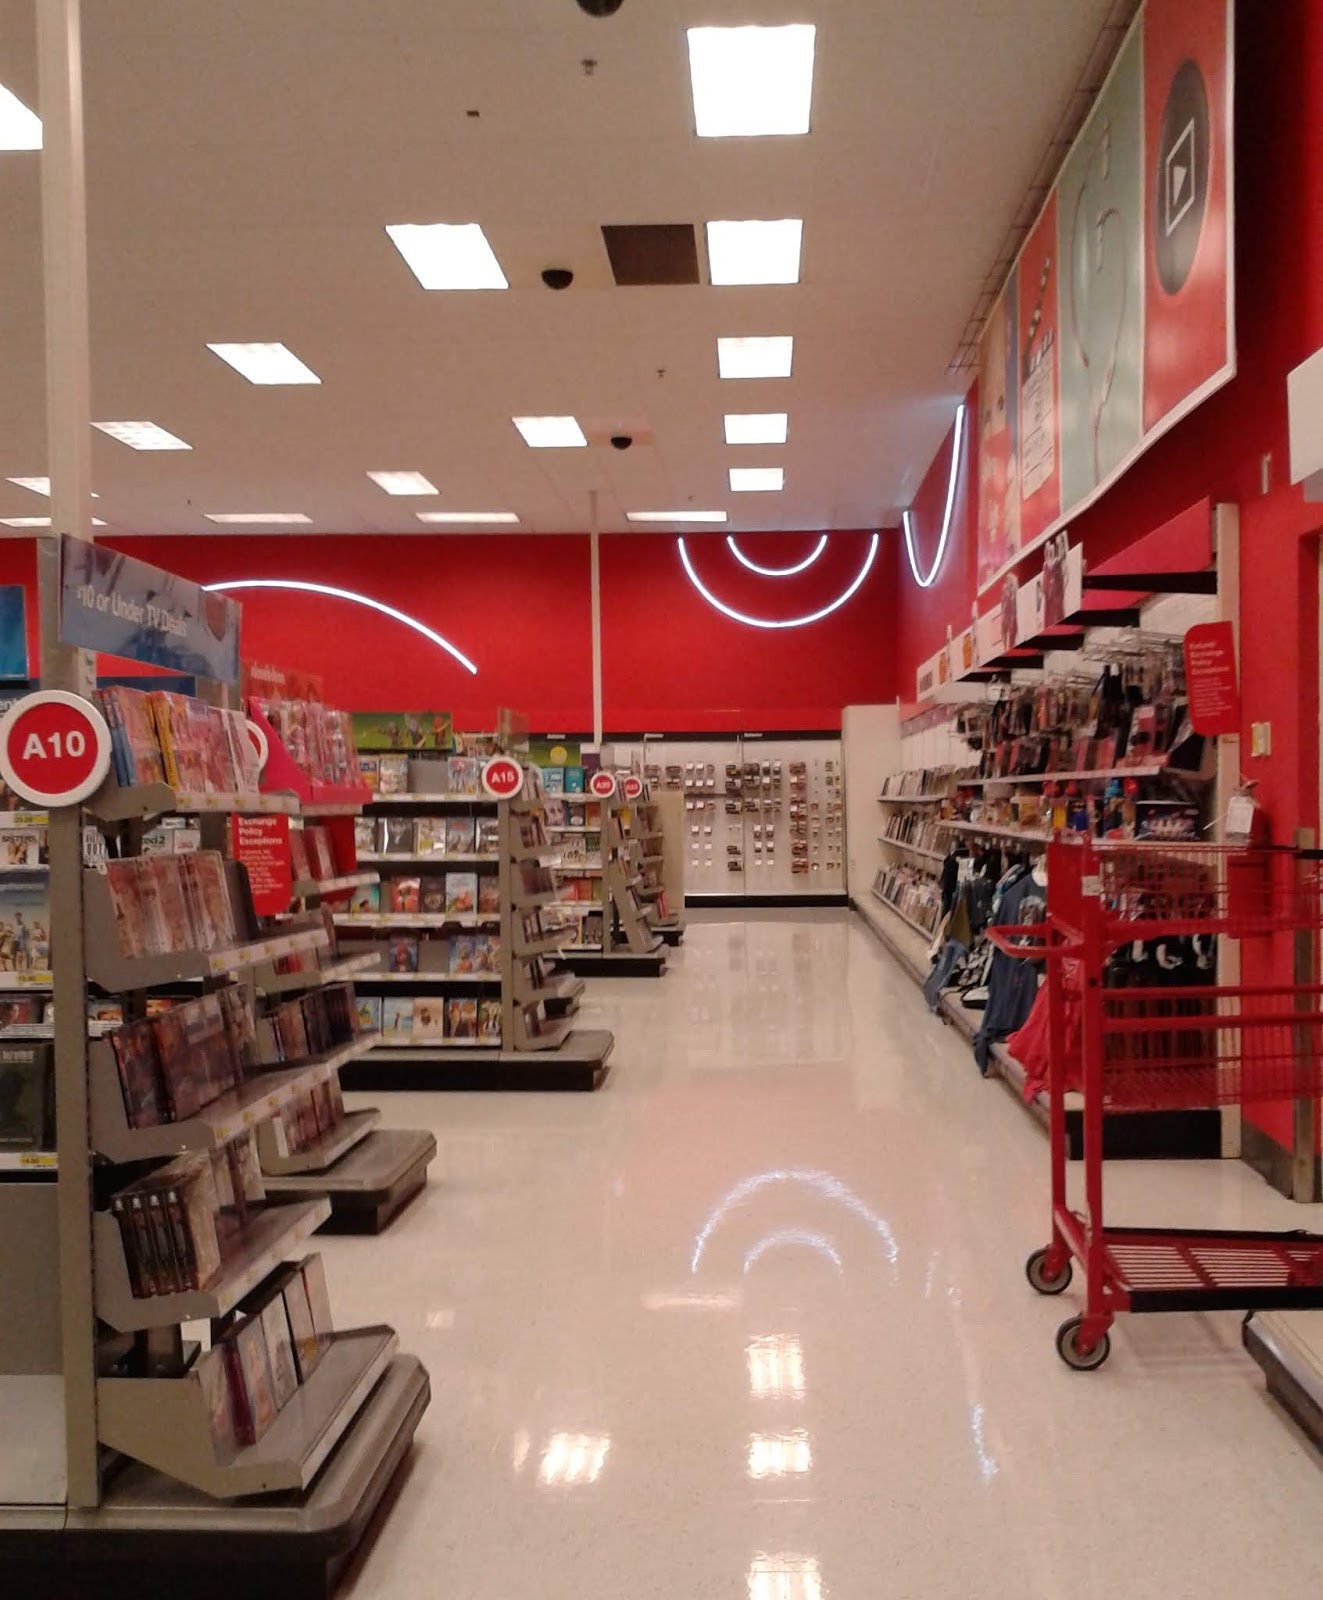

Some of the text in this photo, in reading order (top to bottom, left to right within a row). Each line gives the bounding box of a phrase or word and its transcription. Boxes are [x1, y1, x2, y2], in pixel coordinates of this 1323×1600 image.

[96, 593, 110, 613] or
[111, 591, 145, 624] Under
[22, 730, 86, 761] A10
[491, 772, 516, 785] A15
[238, 816, 278, 827] Exchange
[238, 827, 263, 837] Policy
[238, 837, 283, 846] Exceptions
